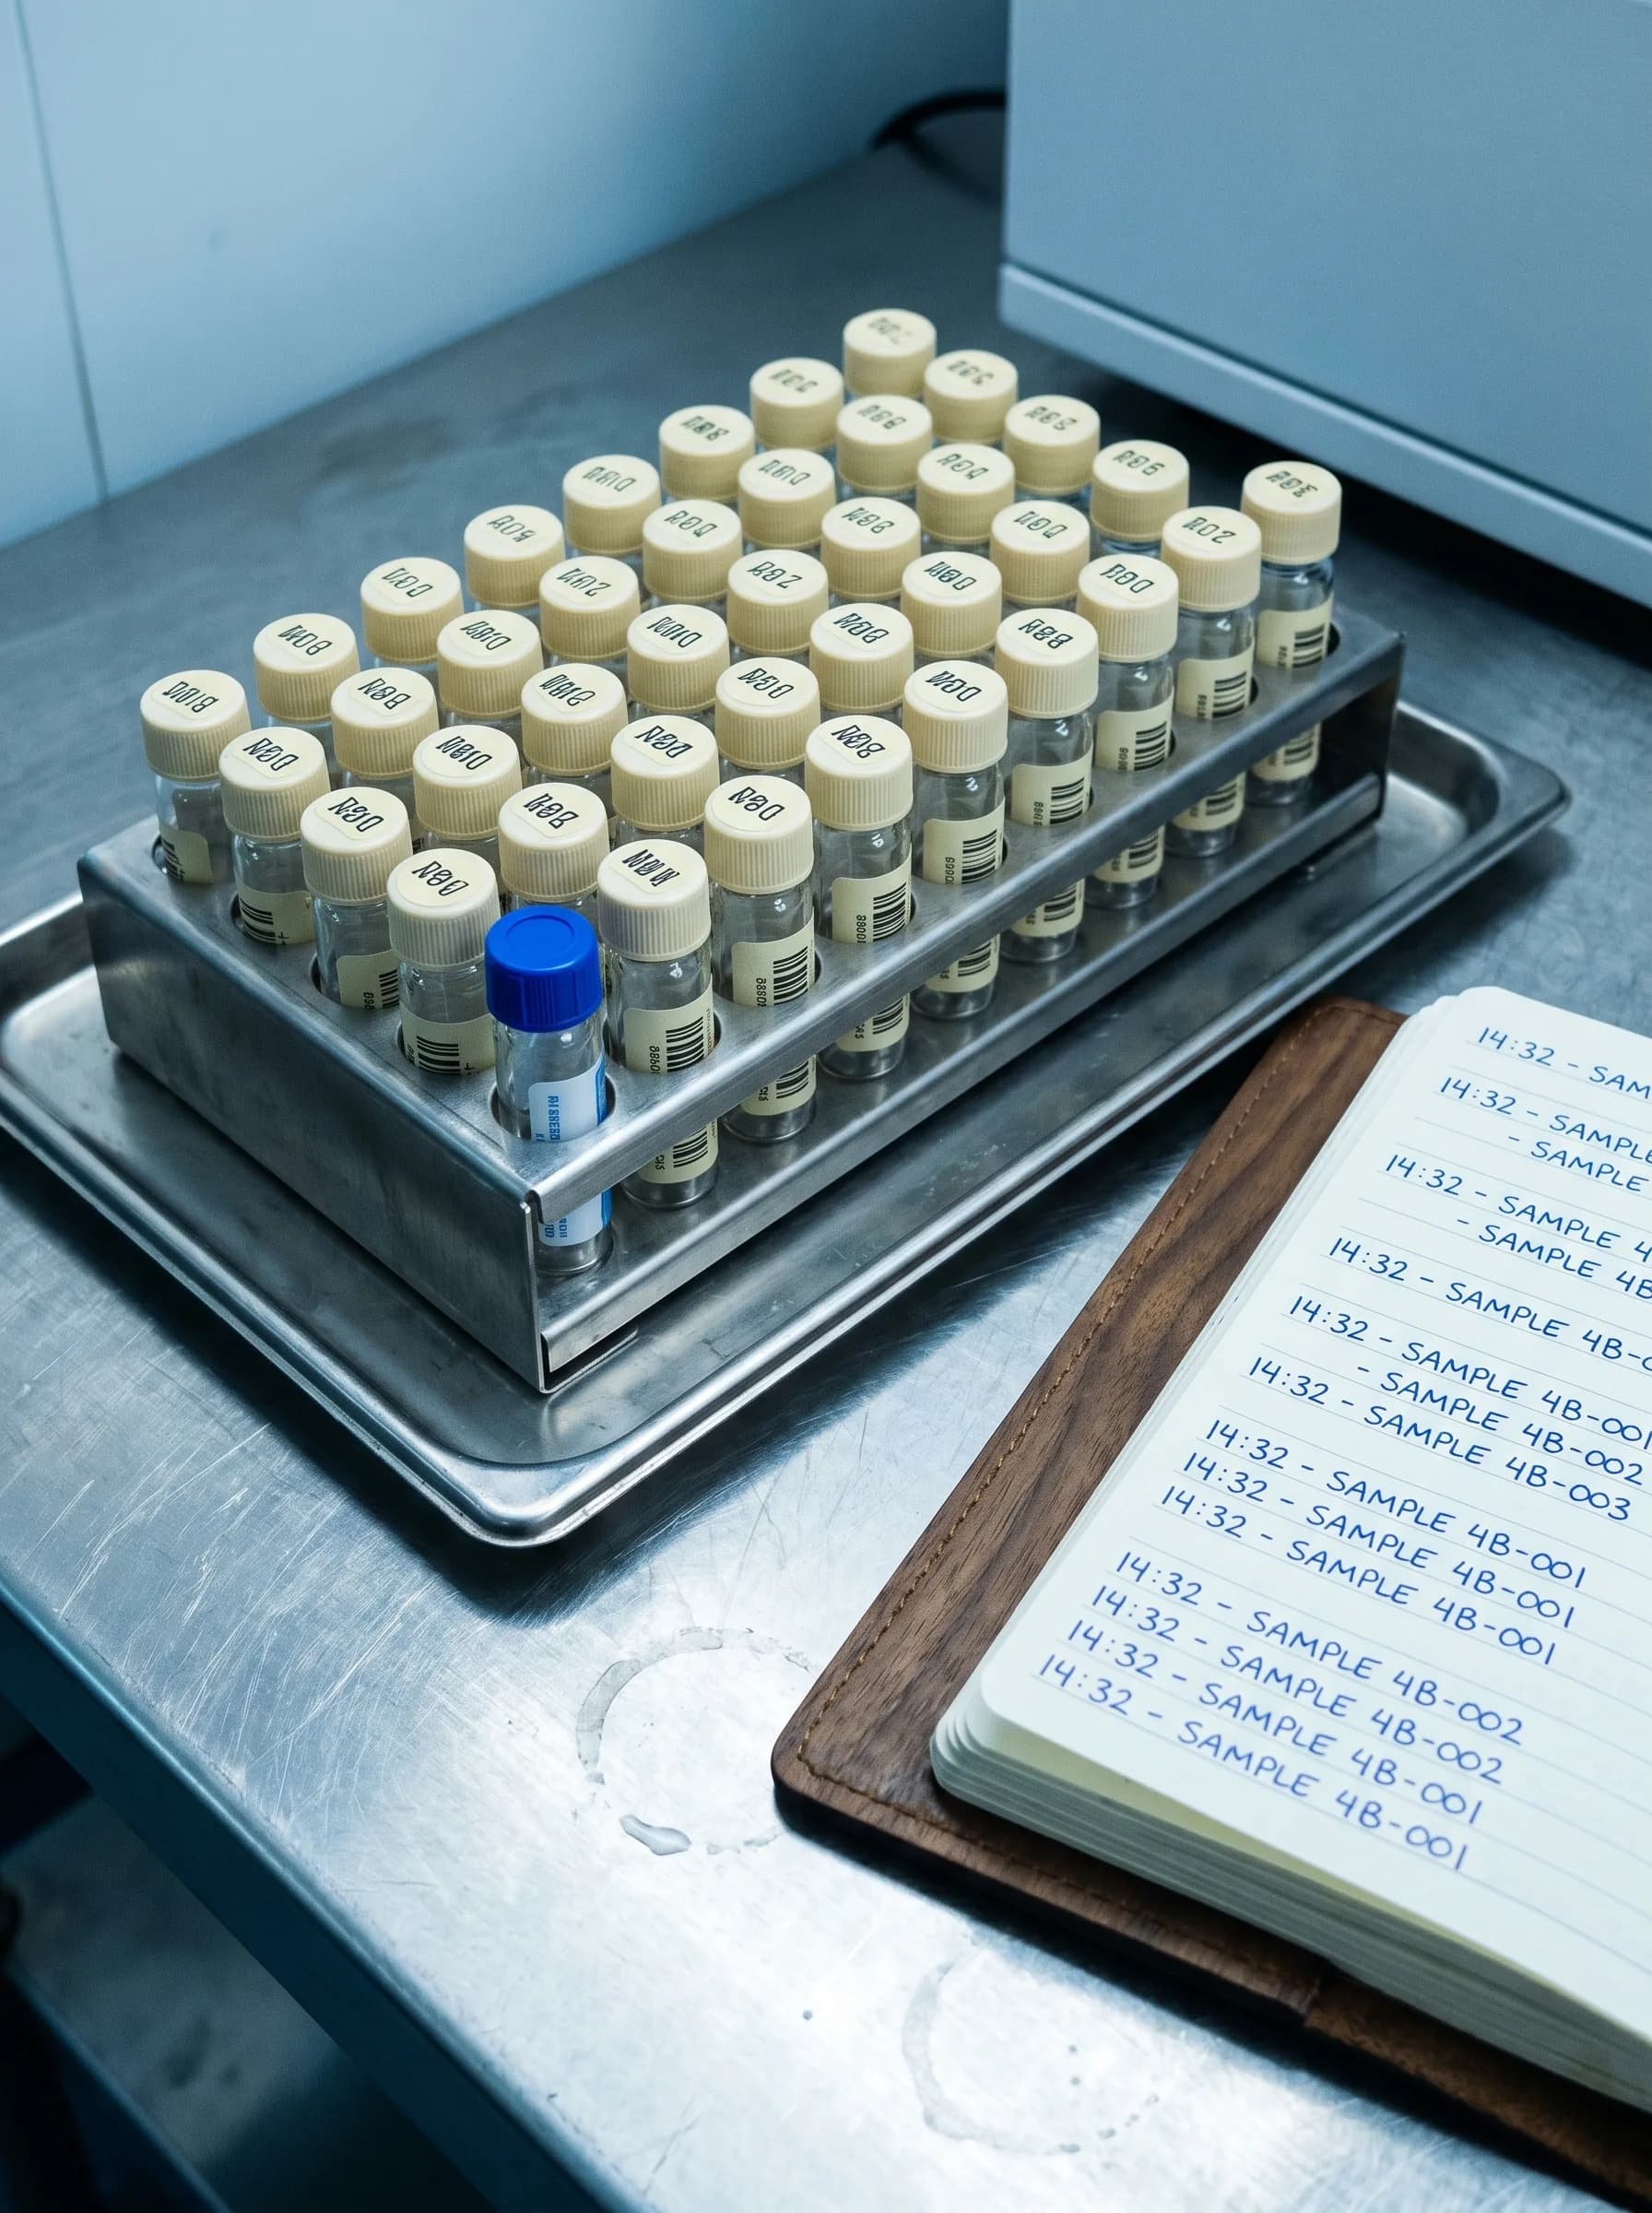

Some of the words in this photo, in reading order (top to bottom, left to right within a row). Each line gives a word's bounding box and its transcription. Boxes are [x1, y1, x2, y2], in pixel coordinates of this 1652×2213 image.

[1440, 1077, 1517, 1117] 14:32
[1478, 1027, 1555, 1066] 14:32
[1589, 1065, 1652, 1099] SAM
[1386, 1154, 1464, 1195] 14:32
[1499, 1195, 1619, 1249] SAMPLE
[1530, 1141, 1646, 1192] SAMPLE
[1328, 1237, 1408, 1282] 14:32
[1446, 1282, 1570, 1338] SAMPLE
[1478, 1225, 1600, 1280] SAMPLE
[1249, 1357, 1328, 1404] 14:32
[1364, 1405, 1490, 1465] SAMPLE
[1505, 1457, 1631, 1521] 4B-003
[1290, 1296, 1369, 1342] 14:32
[1401, 1342, 1526, 1399] SAMPLE
[1541, 1390, 1652, 1450] 4B-001
[1380, 1372, 1506, 1431] SAMPLE
[1522, 1424, 1643, 1485] 4B-002
[1162, 1485, 1246, 1538] 14:32
[1286, 1540, 1416, 1606] SAMPLE
[1433, 1598, 1556, 1666] 4B-001
[1183, 1452, 1268, 1501] 14:32
[1306, 1505, 1437, 1568] SAMPLE
[1452, 1562, 1575, 1629] 4B-001
[1206, 1419, 1289, 1468] 14:32
[1328, 1470, 1456, 1533] SAMPLE
[1468, 1523, 1586, 1589] 4B-001
[1068, 1622, 1159, 1677] 14:32
[1199, 1682, 1335, 1755] SAMPLE
[1351, 1749, 1481, 1825] 4B-001
[1092, 1585, 1179, 1641] 14:32
[1221, 1645, 1356, 1718] SAMPLE
[1371, 1710, 1503, 1784] 4B-002
[1116, 1551, 1202, 1606] 14:32
[1247, 1611, 1380, 1680] SAMPLE
[1392, 1671, 1523, 1746] 4B-002
[1040, 1655, 1132, 1715] 14:32
[1180, 1721, 1316, 1798] SAMPLE
[1336, 1791, 1468, 1871] 4B-001
